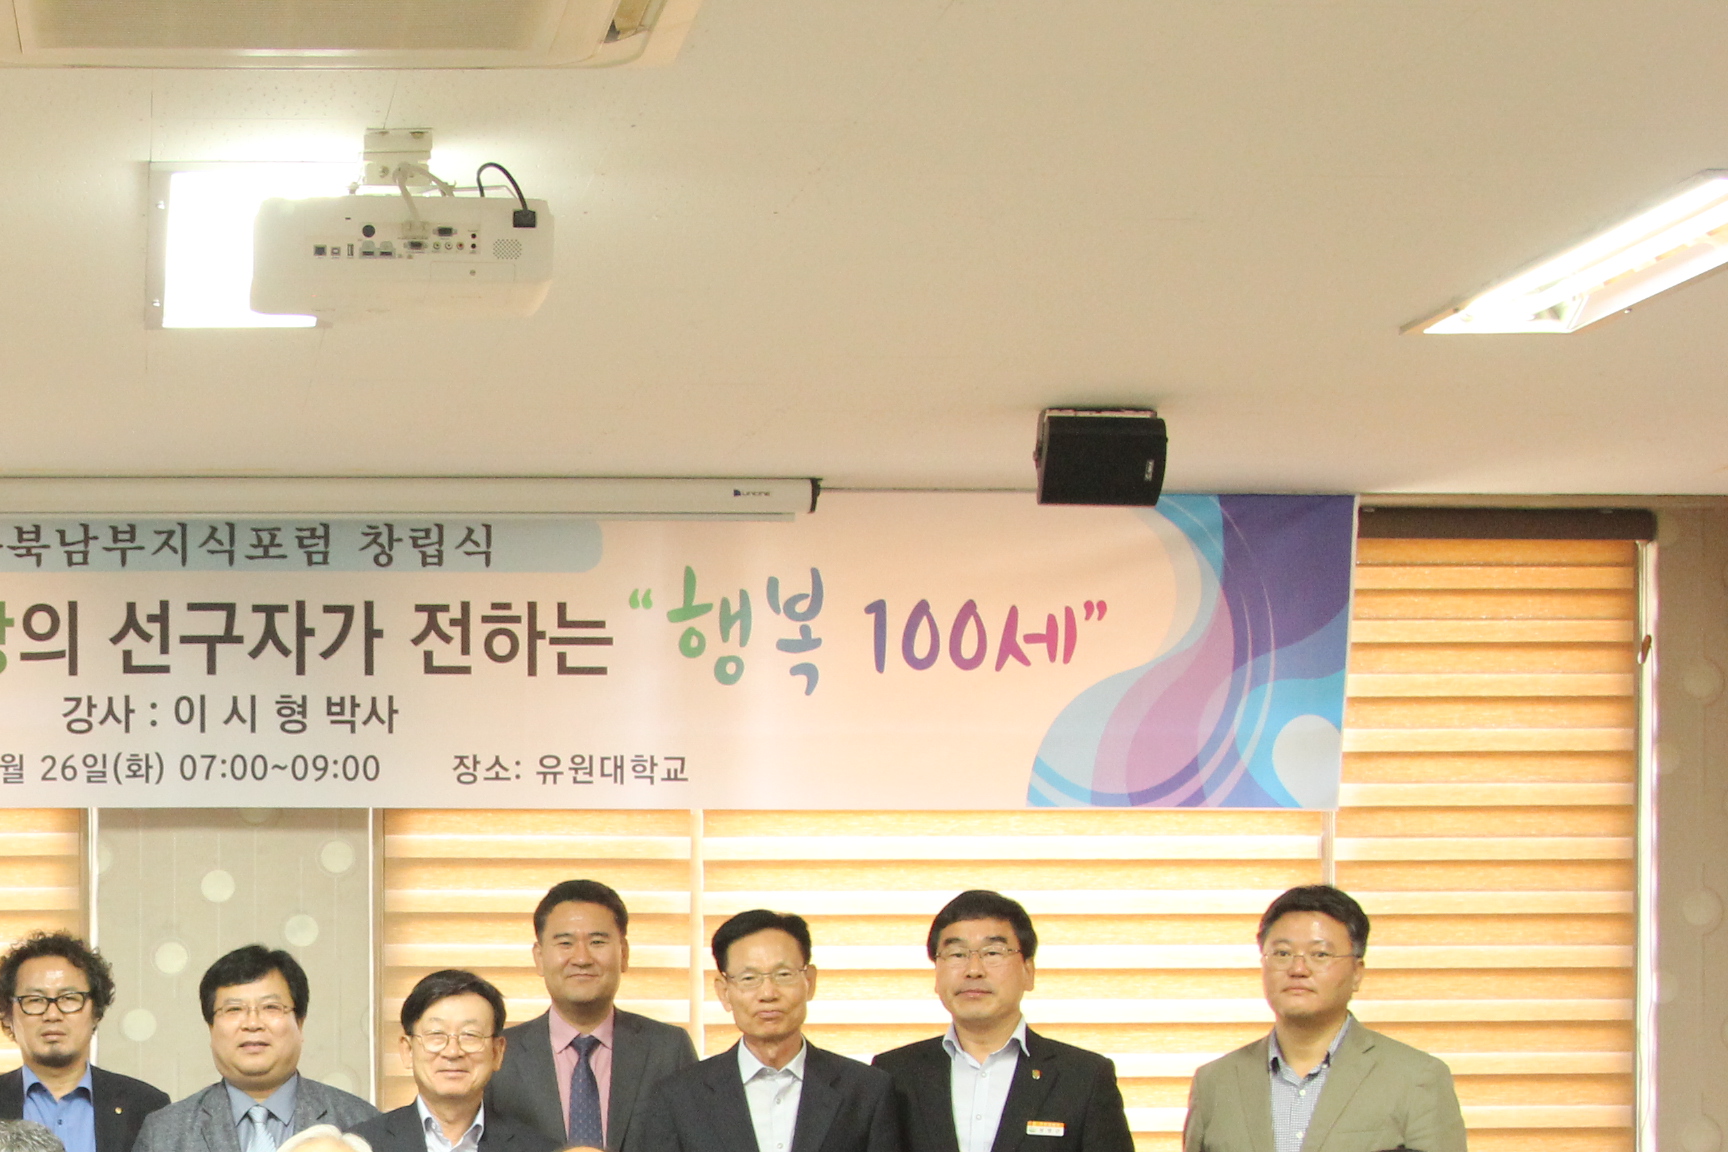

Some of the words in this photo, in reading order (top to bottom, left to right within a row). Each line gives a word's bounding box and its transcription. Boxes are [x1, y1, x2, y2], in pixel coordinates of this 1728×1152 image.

[359, 522, 492, 568] 창립식
[109, 600, 383, 676] 선구자가
[410, 601, 613, 677] 전하는
[326, 695, 399, 734] 박사
[41, 752, 164, 784] 26일(화)
[180, 754, 380, 782] 07:00~09:00
[452, 753, 521, 785] 장소:
[536, 753, 689, 785] 유원대학교
